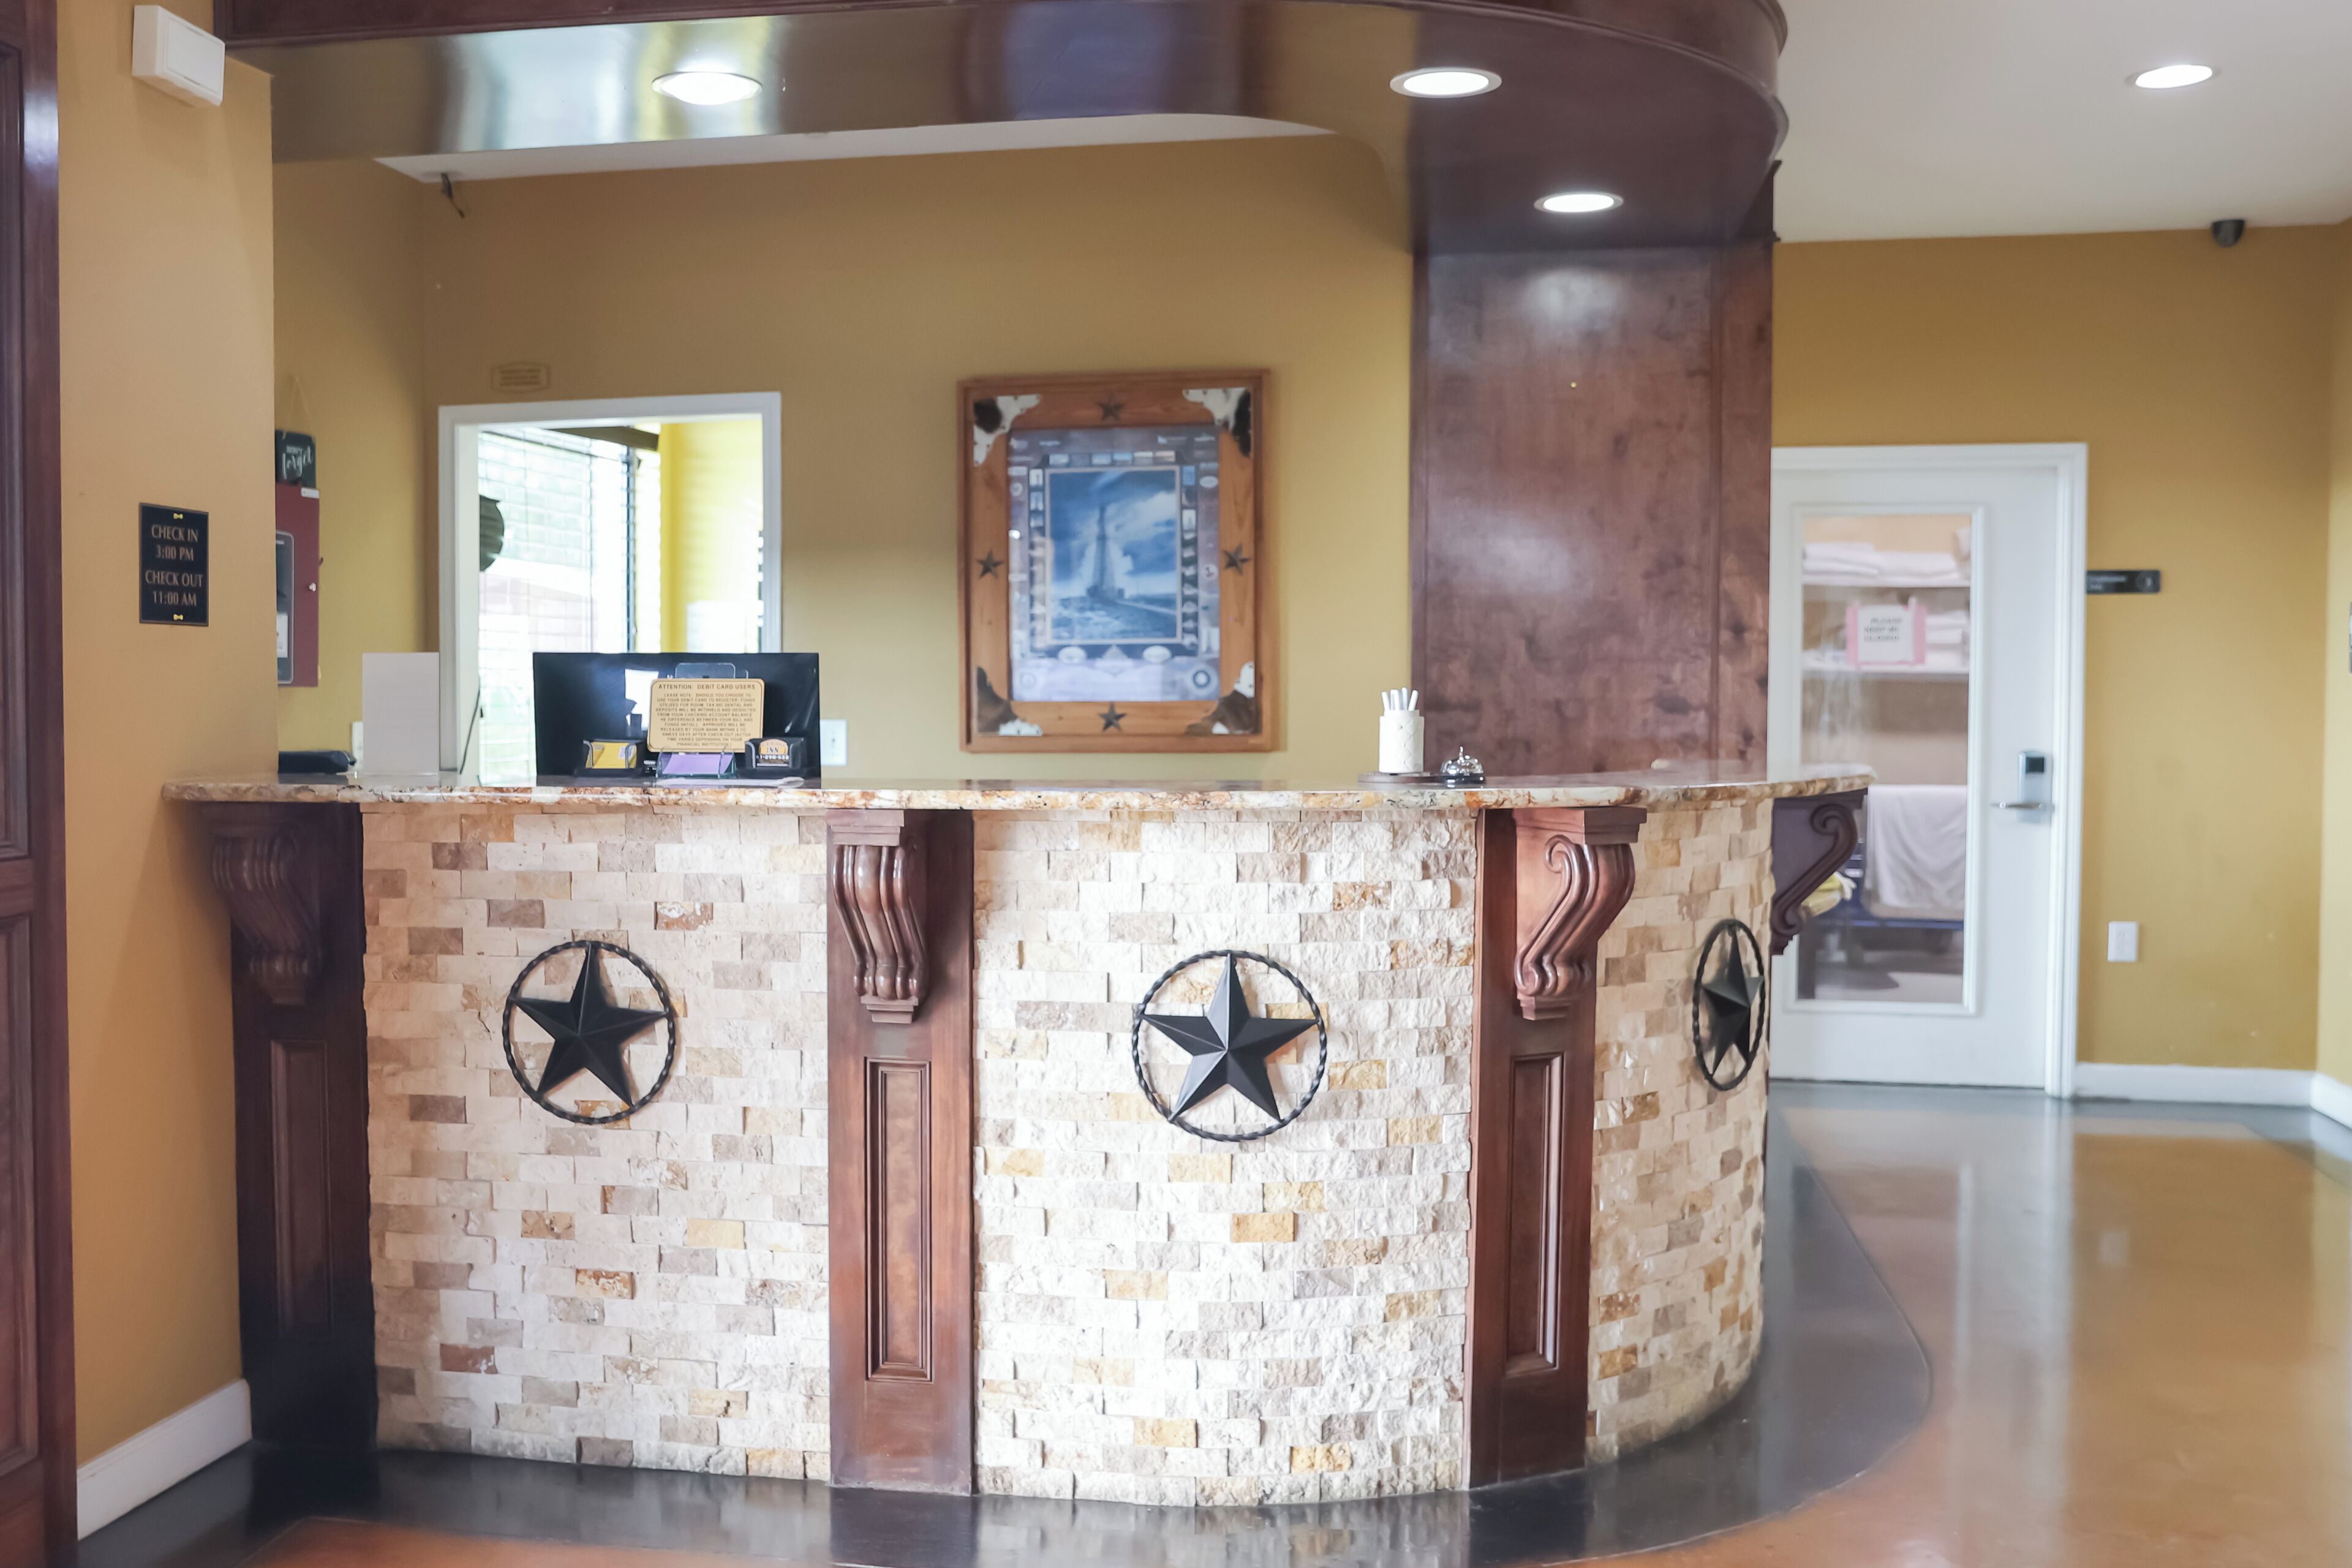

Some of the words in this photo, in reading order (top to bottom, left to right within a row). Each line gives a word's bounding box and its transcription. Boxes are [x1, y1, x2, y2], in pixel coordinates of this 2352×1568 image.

[151, 524, 186, 541] CHECK
[187, 528, 198, 543] IN
[156, 545, 176, 560] 3:00
[179, 546, 194, 562] PM
[145, 569, 179, 586] CHECK
[181, 573, 204, 588] OUT
[153, 590, 179, 605] 11:00
[181, 592, 197, 607] AM
